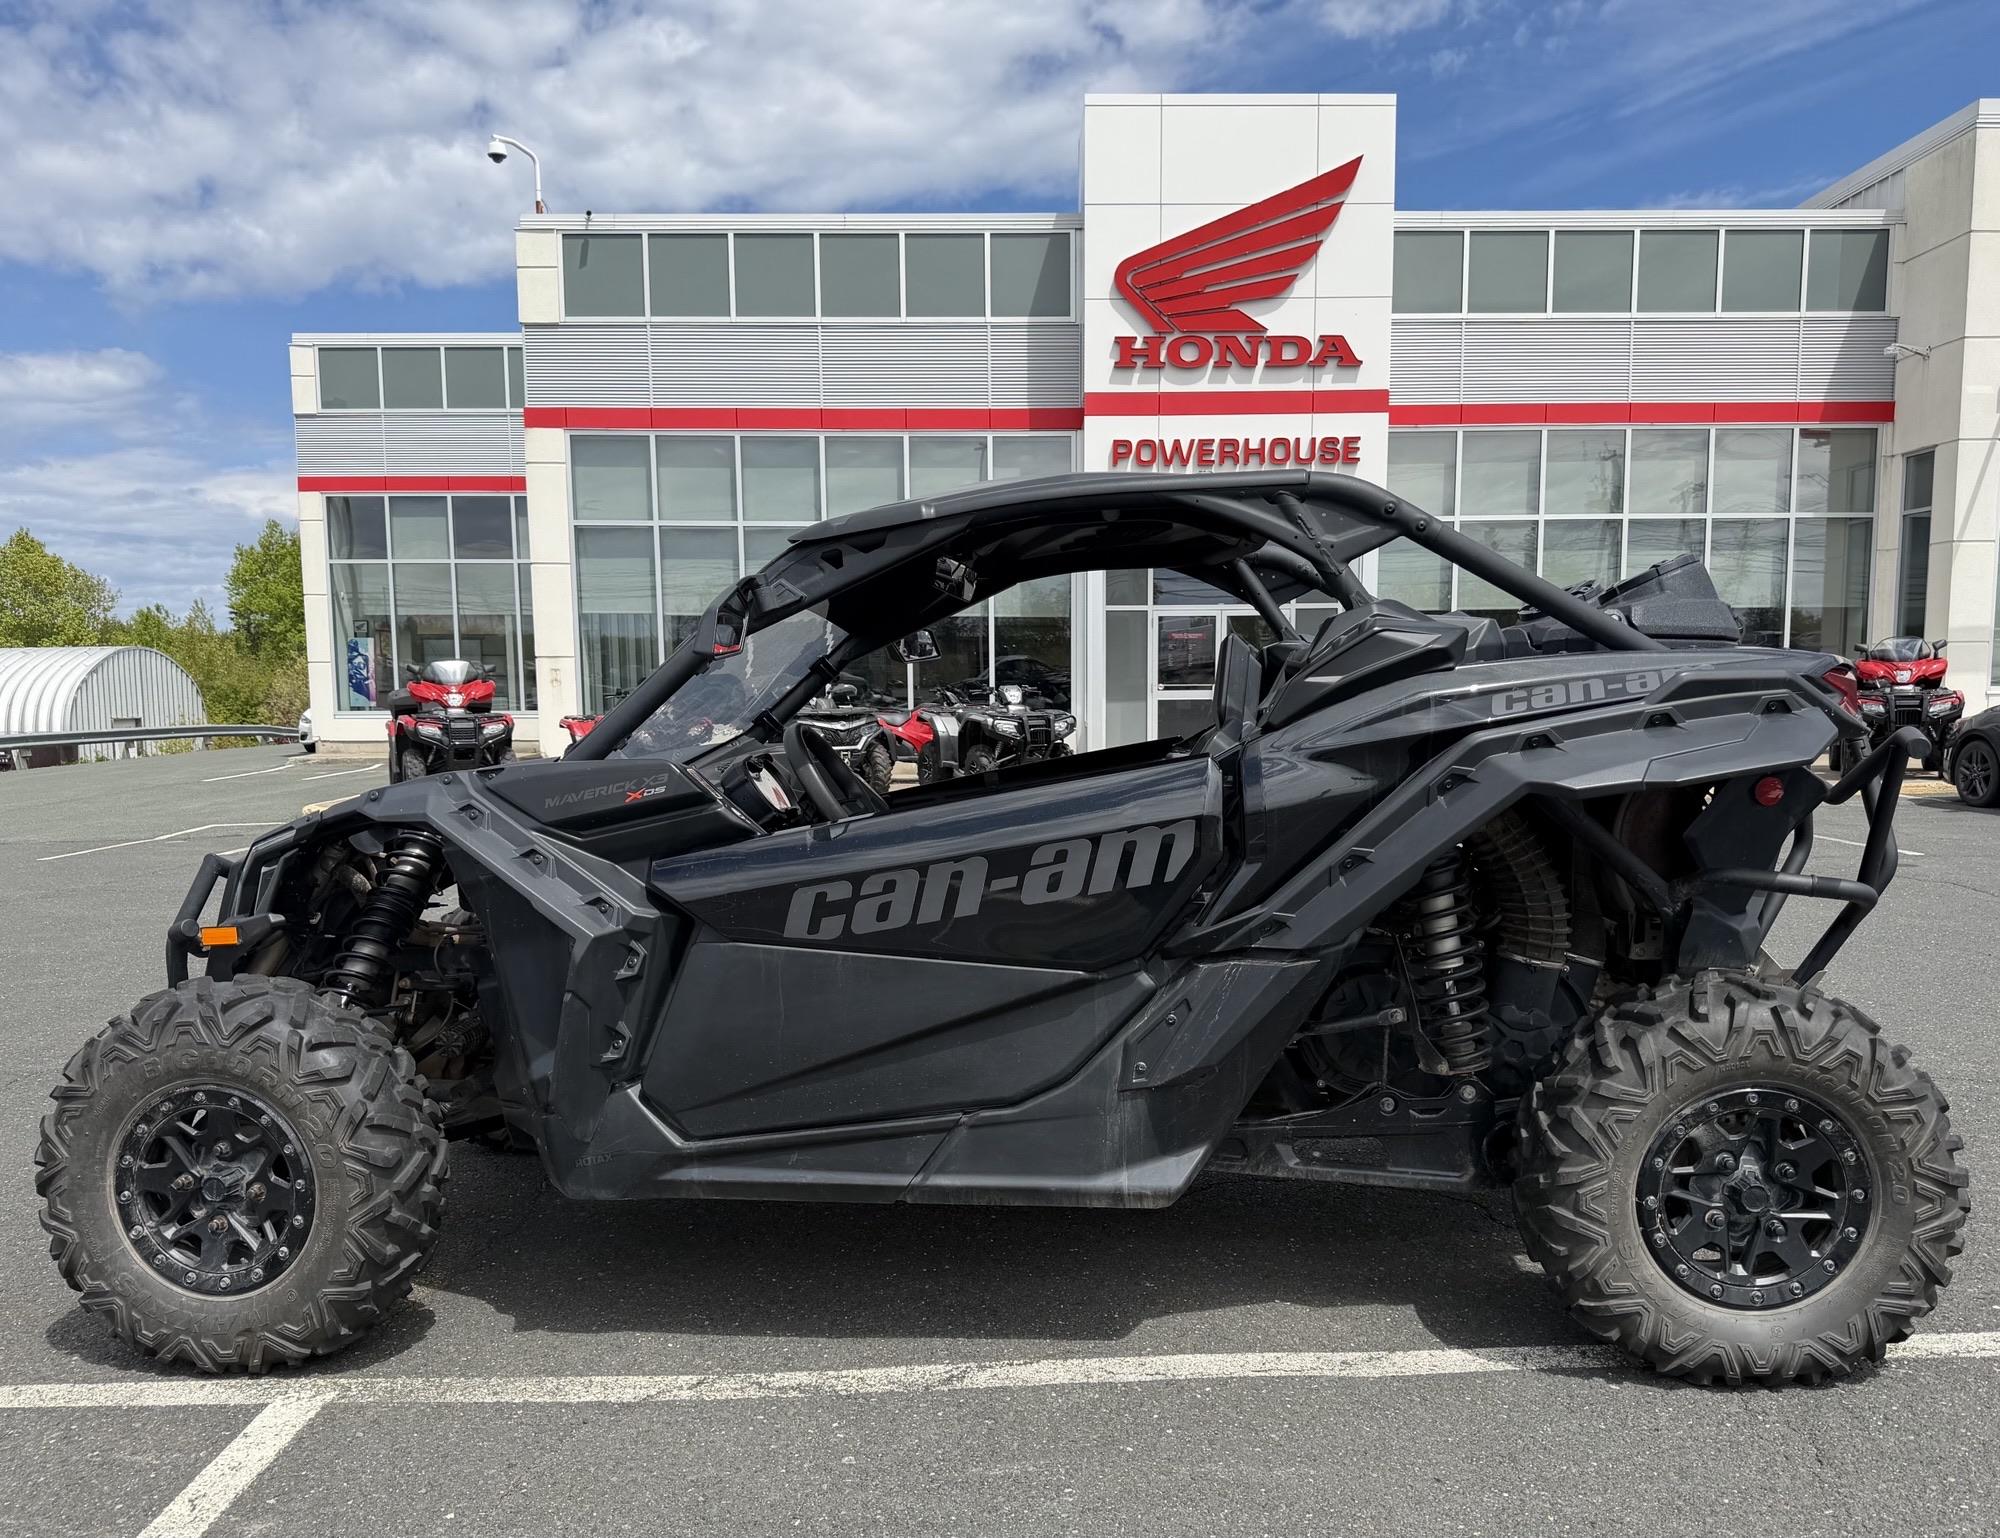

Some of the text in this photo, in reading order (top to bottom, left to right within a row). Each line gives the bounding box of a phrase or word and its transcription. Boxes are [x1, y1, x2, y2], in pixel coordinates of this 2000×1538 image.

[1113, 335, 1363, 368] HONDA
[1112, 436, 1361, 466] POWERHOUSE
[1491, 669, 1678, 716] can-a
[545, 773, 669, 808] MAVERICK X3
[784, 820, 1196, 941] can-am
[143, 1048, 304, 1108] BIGHORN
